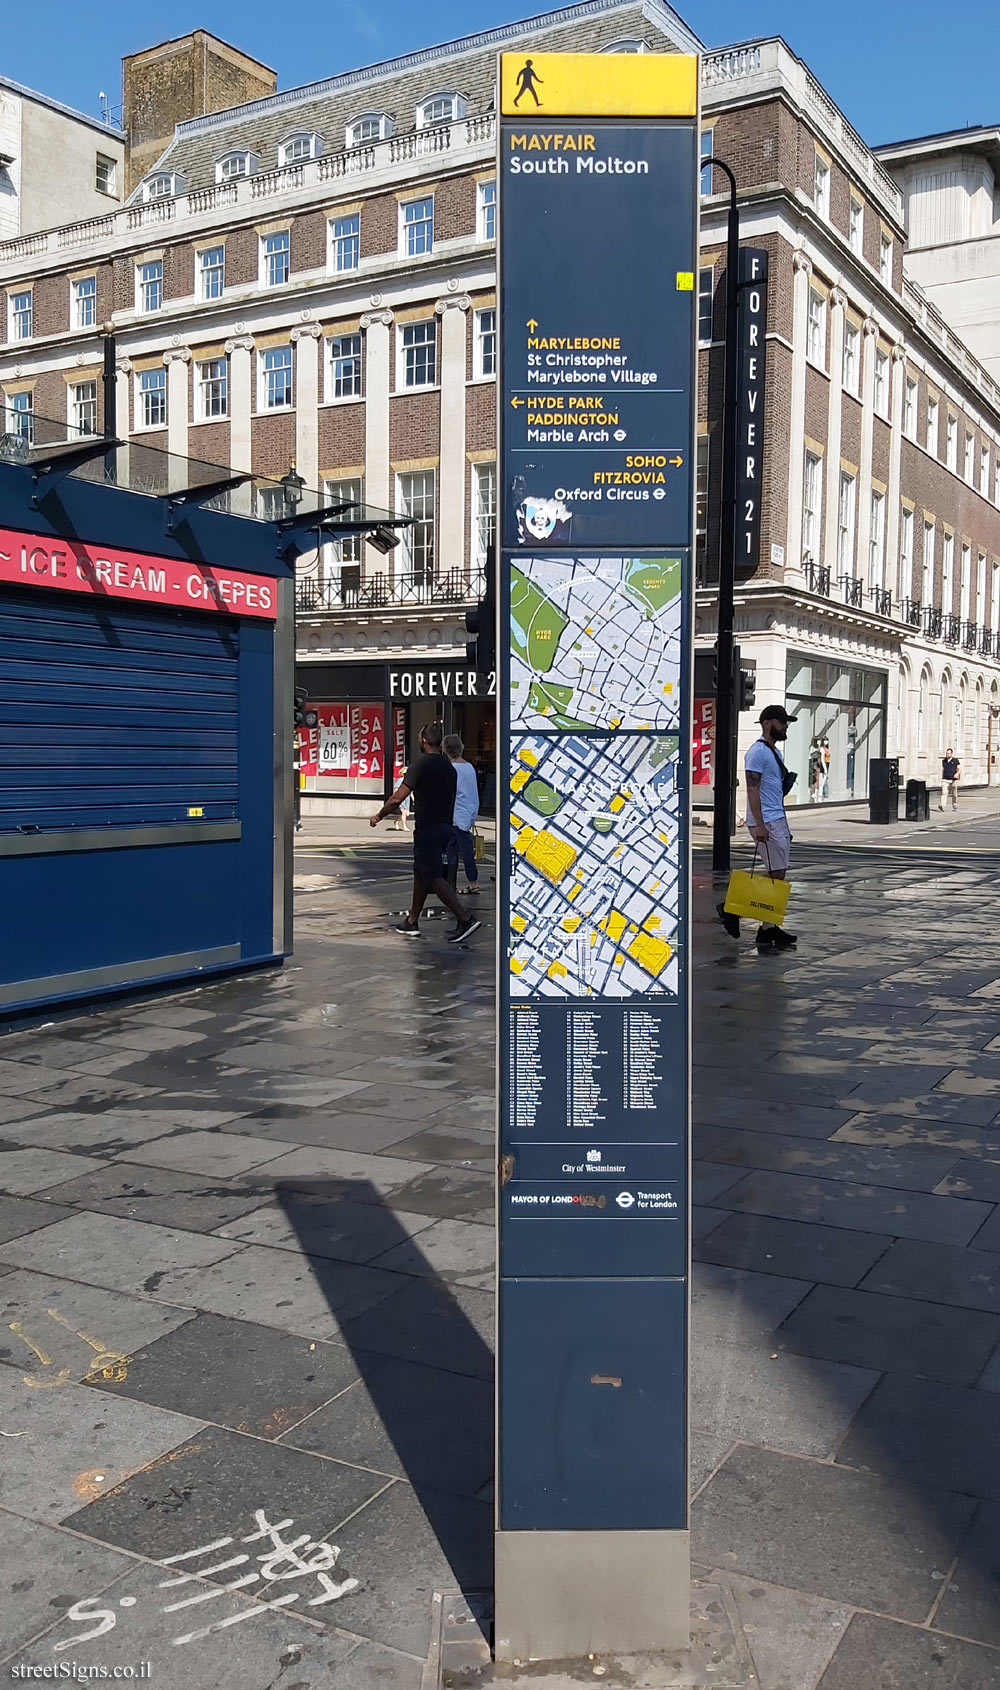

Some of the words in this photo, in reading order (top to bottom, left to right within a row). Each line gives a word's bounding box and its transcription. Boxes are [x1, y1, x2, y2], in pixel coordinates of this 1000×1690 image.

[510, 134, 596, 150] MAYFAIR
[510, 156, 568, 174] South
[576, 156, 648, 174] Molton
[528, 338, 621, 350] MARYLEBONE
[528, 354, 542, 366] St
[546, 354, 628, 368] Christopher
[746, 256, 760, 480] FOREVER
[528, 370, 606, 385] Marylebone
[610, 370, 658, 384] Village
[528, 397, 564, 409] HYDE
[568, 397, 604, 409] PARK
[528, 413, 618, 425] PADDINGTON
[528, 430, 574, 442] Marble
[578, 430, 609, 442] Arch
[626, 456, 666, 468] SOHO
[594, 472, 666, 484] FITZROVIA
[554, 488, 602, 501] Oxford
[606, 488, 650, 500] Circus
[744, 500, 754, 554] 21
[20, 544, 67, 577] ICE
[76, 556, 166, 593] CREAM
[187, 574, 272, 609] CREPES
[390, 672, 477, 697] FOREVER
[554, 783, 665, 793] MARYLEBONE
[507, 947, 575, 958] MAYFAIR
[562, 1164, 575, 1173] City
[576, 1164, 585, 1172] of
[586, 1164, 626, 1172] Westminster
[637, 1192, 672, 1200] Transport
